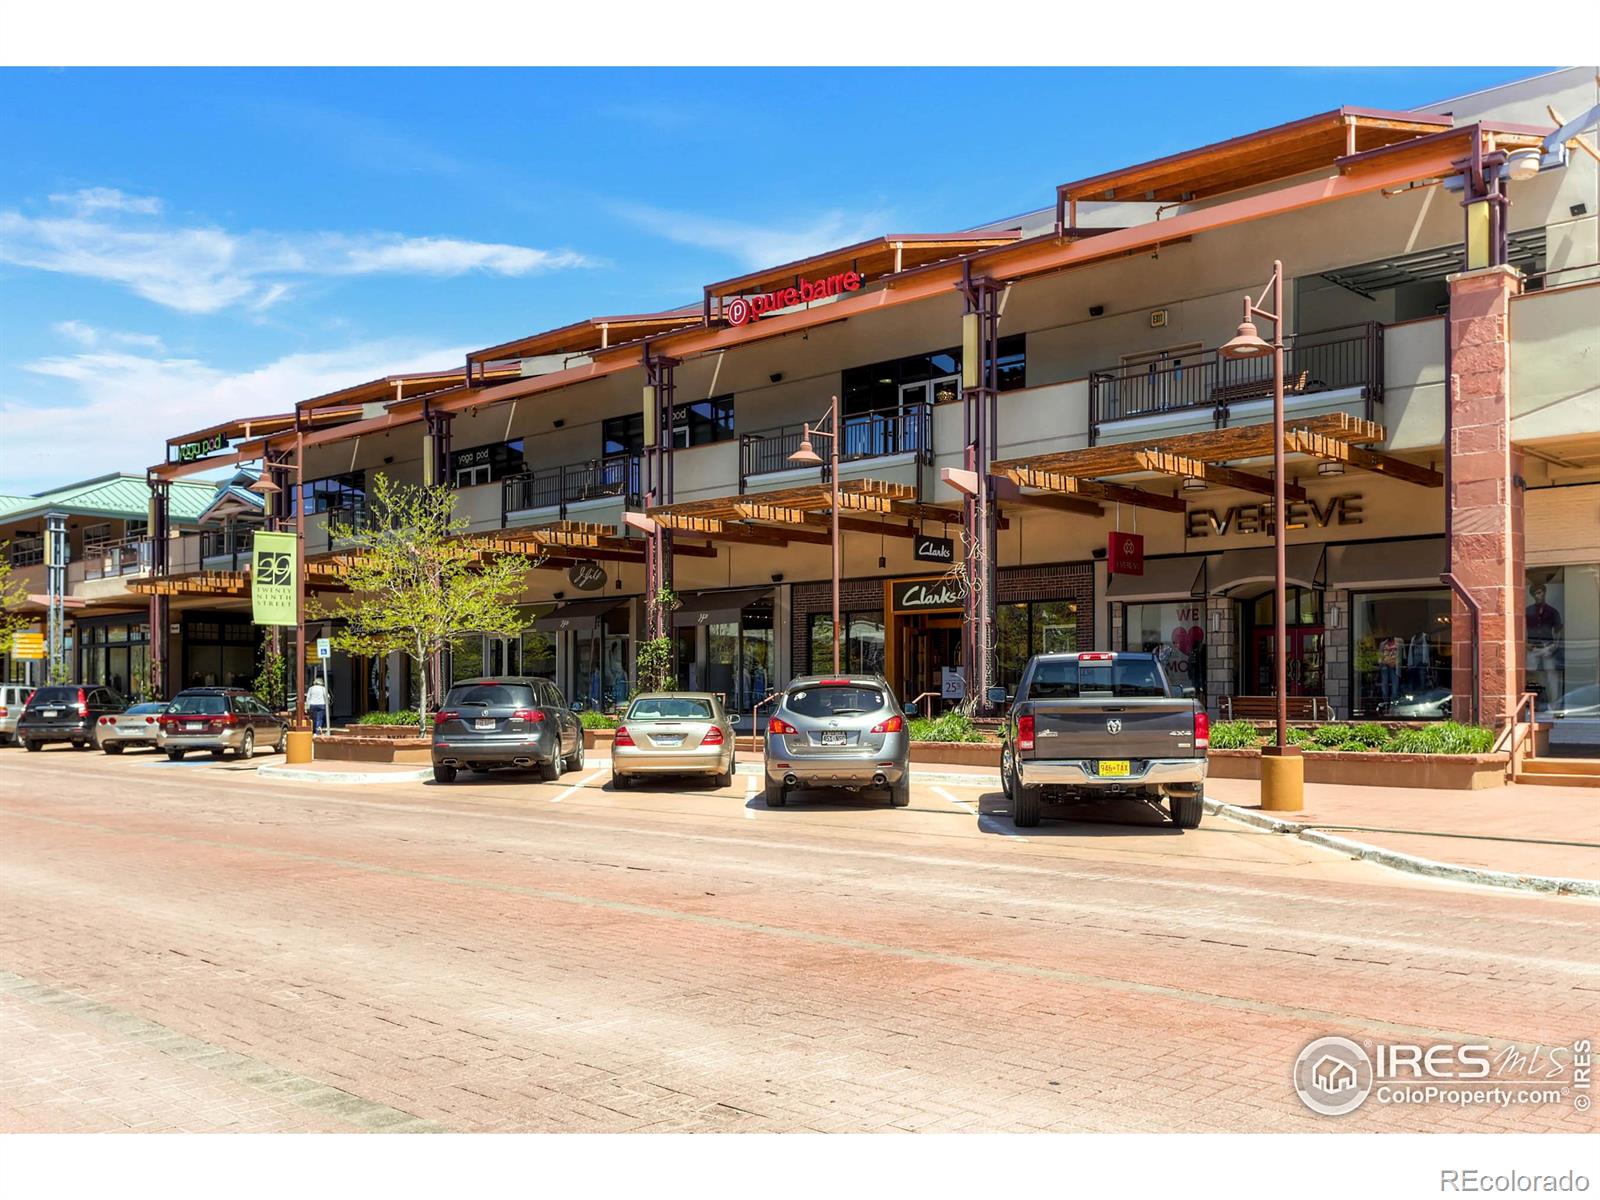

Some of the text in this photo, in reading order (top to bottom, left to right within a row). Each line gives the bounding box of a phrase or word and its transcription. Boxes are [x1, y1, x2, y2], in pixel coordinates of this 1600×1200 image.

[752, 287, 799, 321] pure
[800, 271, 861, 302] barre
[202, 432, 221, 456] pod
[458, 448, 489, 465] yoga pod
[1185, 494, 1363, 539] EVEREVE
[918, 541, 951, 558] Clarks
[257, 554, 292, 586] 29
[902, 585, 956, 606] Clarks
[1176, 608, 1200, 622] WE
